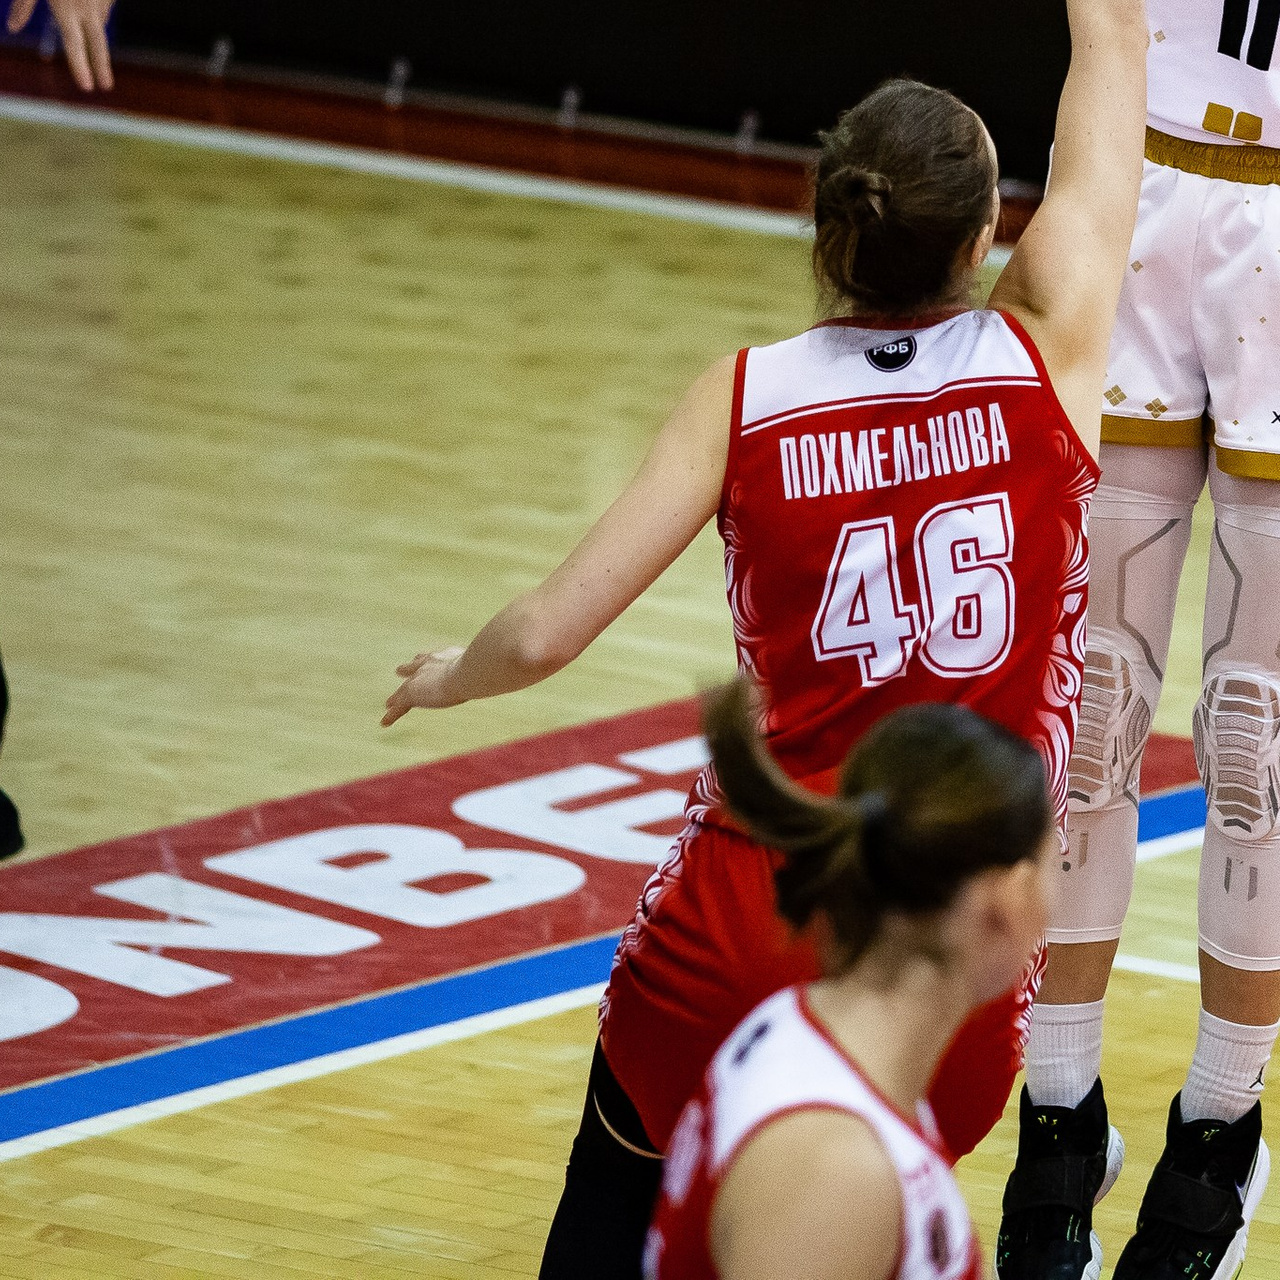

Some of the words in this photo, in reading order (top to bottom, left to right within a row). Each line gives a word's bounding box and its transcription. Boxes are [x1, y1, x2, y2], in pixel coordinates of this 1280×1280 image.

[779, 402, 1011, 500] ПОХМЕЛЬНОВА
[810, 491, 1015, 688] 46
[0, 734, 713, 1042] NBE
